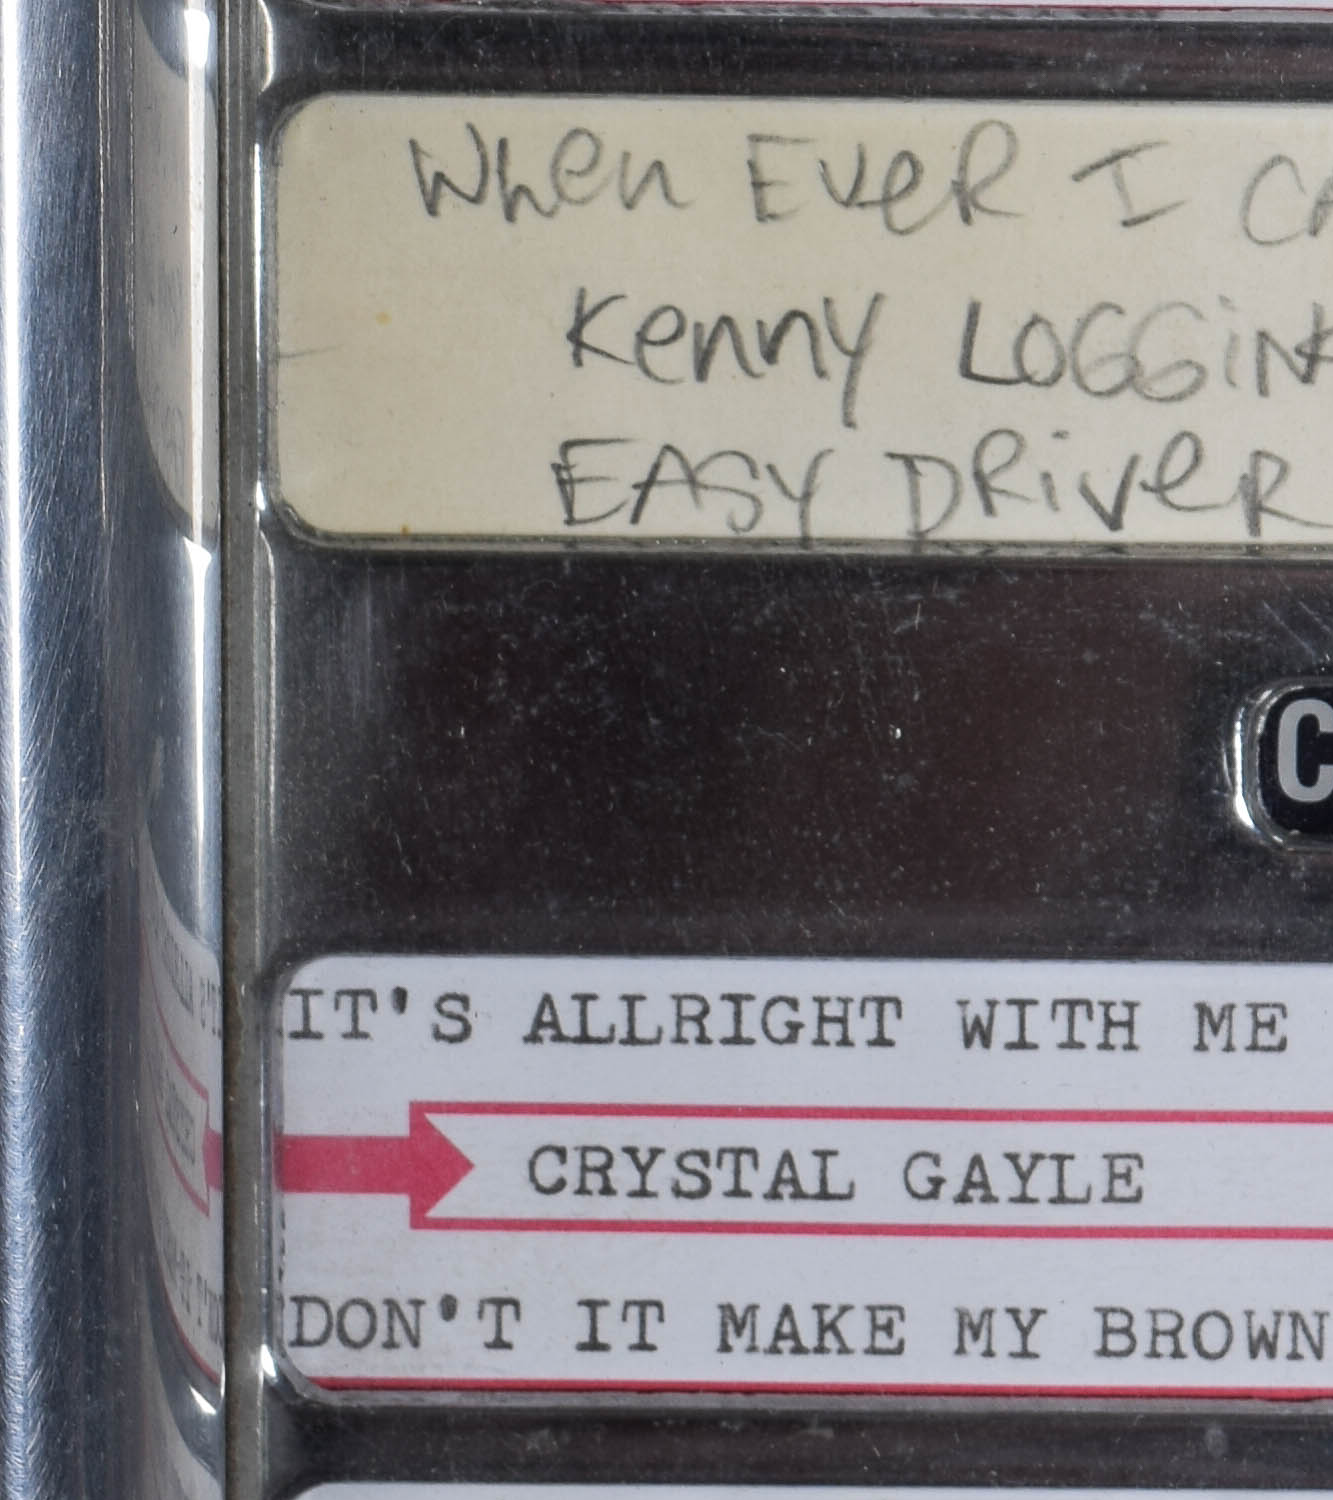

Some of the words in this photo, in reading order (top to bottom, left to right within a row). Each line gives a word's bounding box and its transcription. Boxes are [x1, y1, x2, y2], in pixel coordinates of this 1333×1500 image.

[545, 437, 848, 542] EASY
[279, 978, 472, 1045] IT'S
[522, 993, 902, 1048] ALLRIGHT
[956, 998, 1140, 1052] WITH
[1193, 1002, 1288, 1053] ME
[528, 1144, 855, 1202] CRYSTAL
[903, 1150, 1144, 1205] GAYLE
[288, 1293, 522, 1351] DON'T
[575, 1299, 665, 1353] IT
[716, 1303, 905, 1356] MAKE
[953, 1307, 1047, 1360] MY
[1094, 1306, 1330, 1362] BROWN
